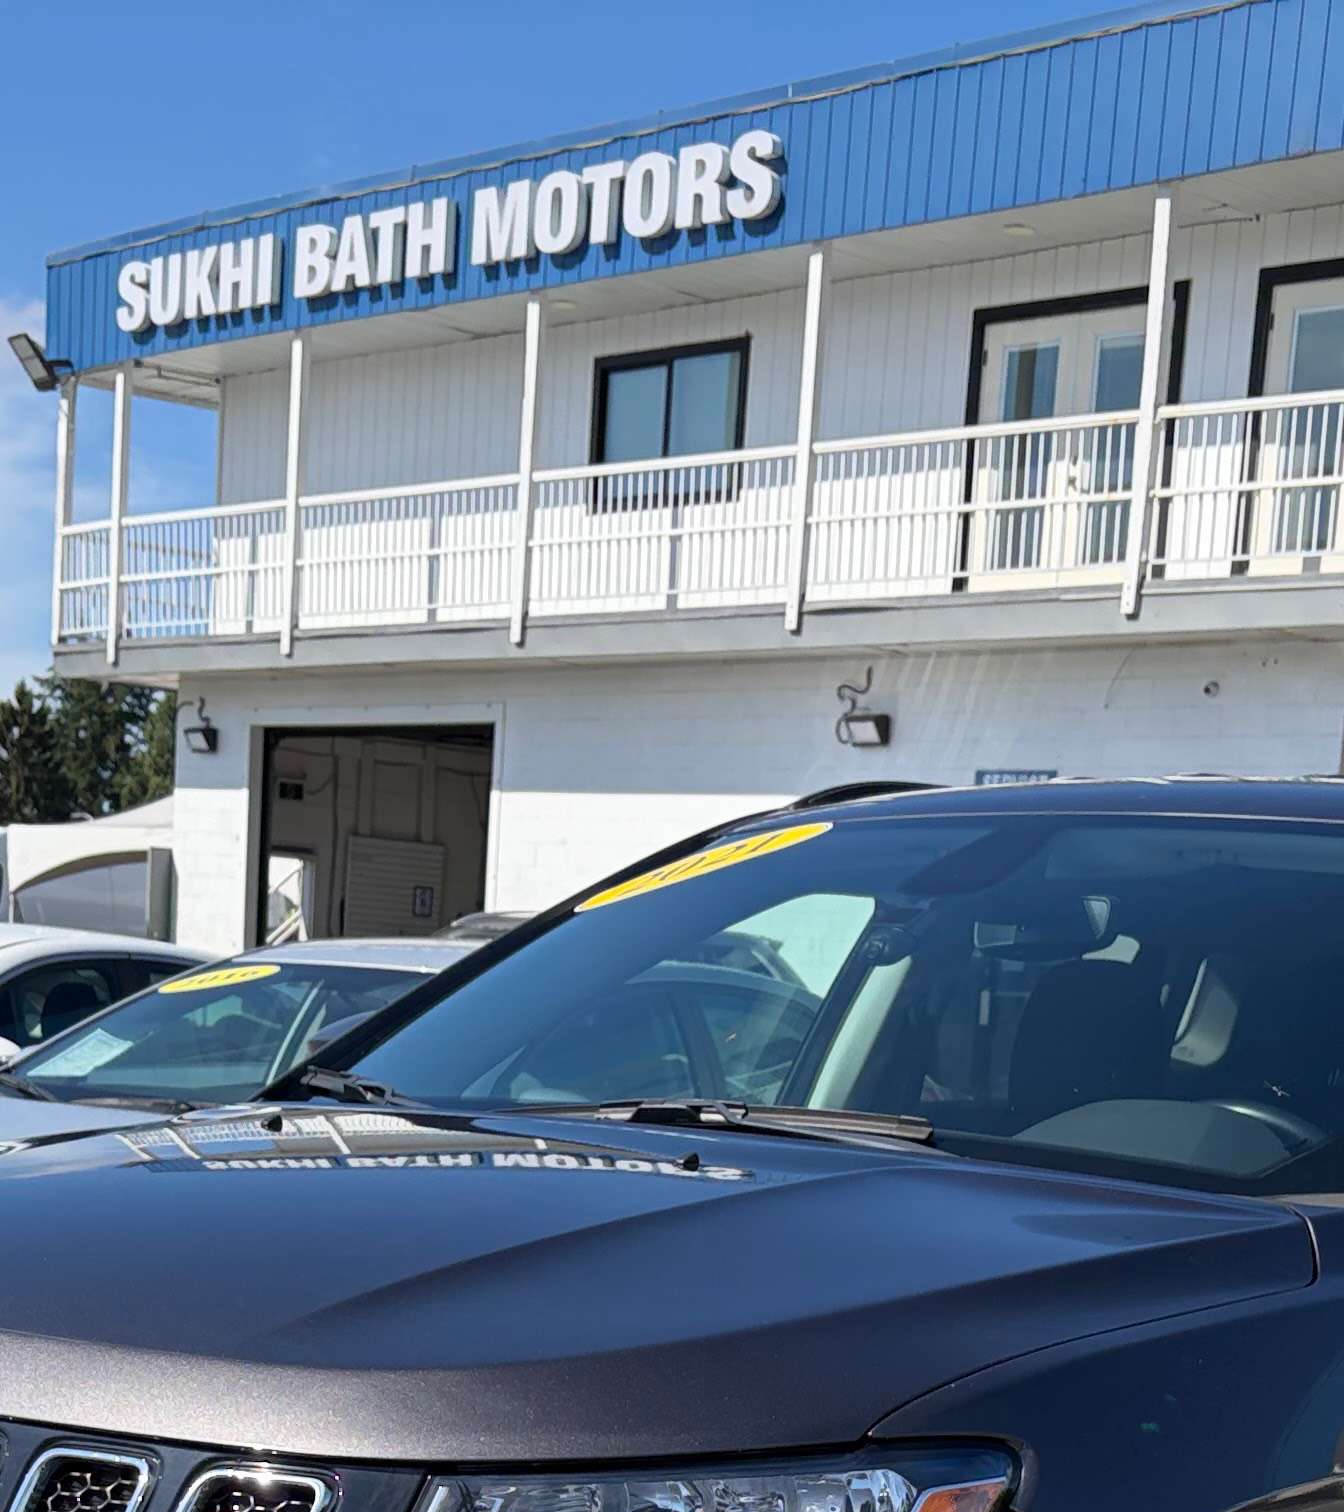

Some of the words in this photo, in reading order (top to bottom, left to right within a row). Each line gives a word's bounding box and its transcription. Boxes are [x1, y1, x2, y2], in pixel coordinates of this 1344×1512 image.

[116, 233, 281, 333] SUKHI
[294, 197, 455, 299] BATH
[470, 130, 784, 266] MOTORS
